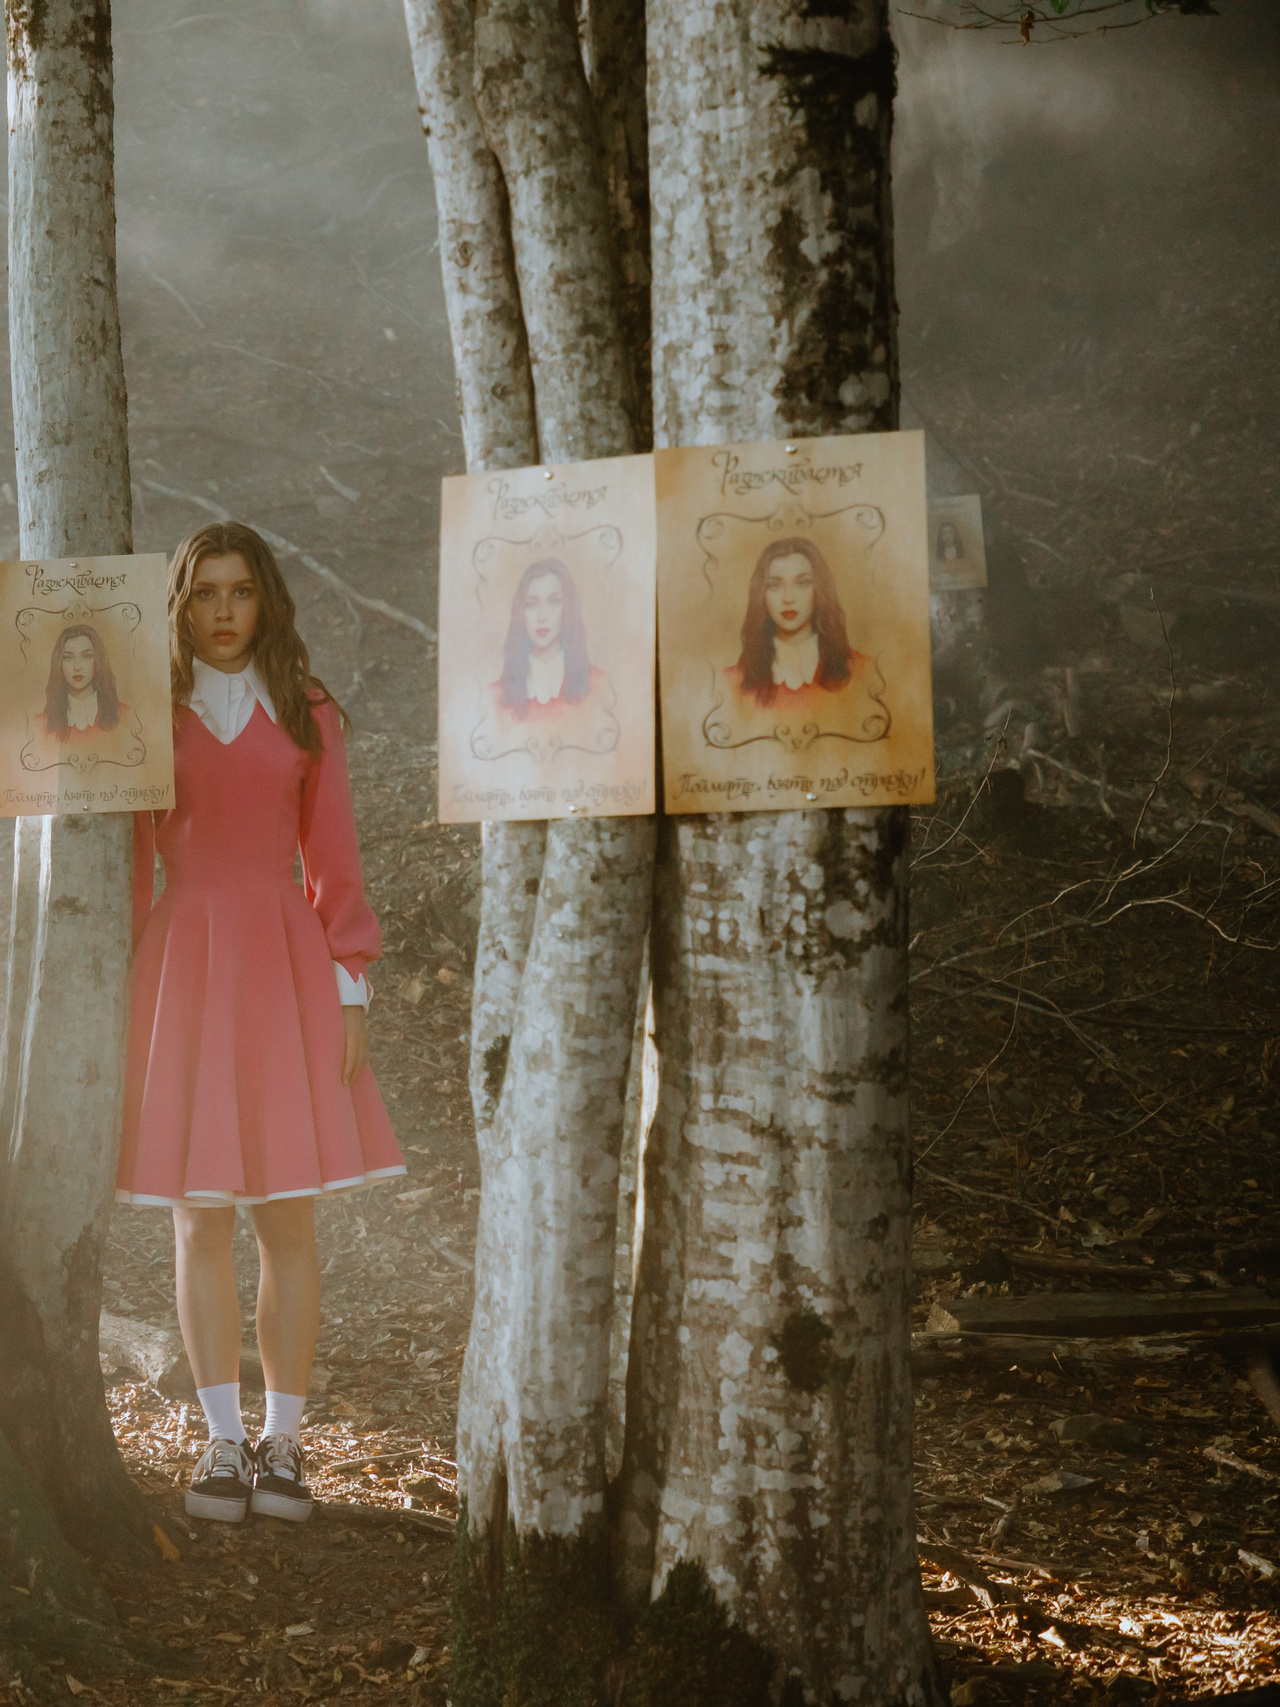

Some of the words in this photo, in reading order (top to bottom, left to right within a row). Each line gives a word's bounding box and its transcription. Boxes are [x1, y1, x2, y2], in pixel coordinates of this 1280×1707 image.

[711, 450, 864, 495] Разыскивается
[487, 477, 608, 519] Разыскивается
[25, 564, 127, 598] Разыскивается
[99, 784, 118, 802] под
[119, 784, 170, 804] стражу!
[561, 779, 585, 803] под
[820, 768, 848, 792] под
[850, 767, 926, 796] стражу!
